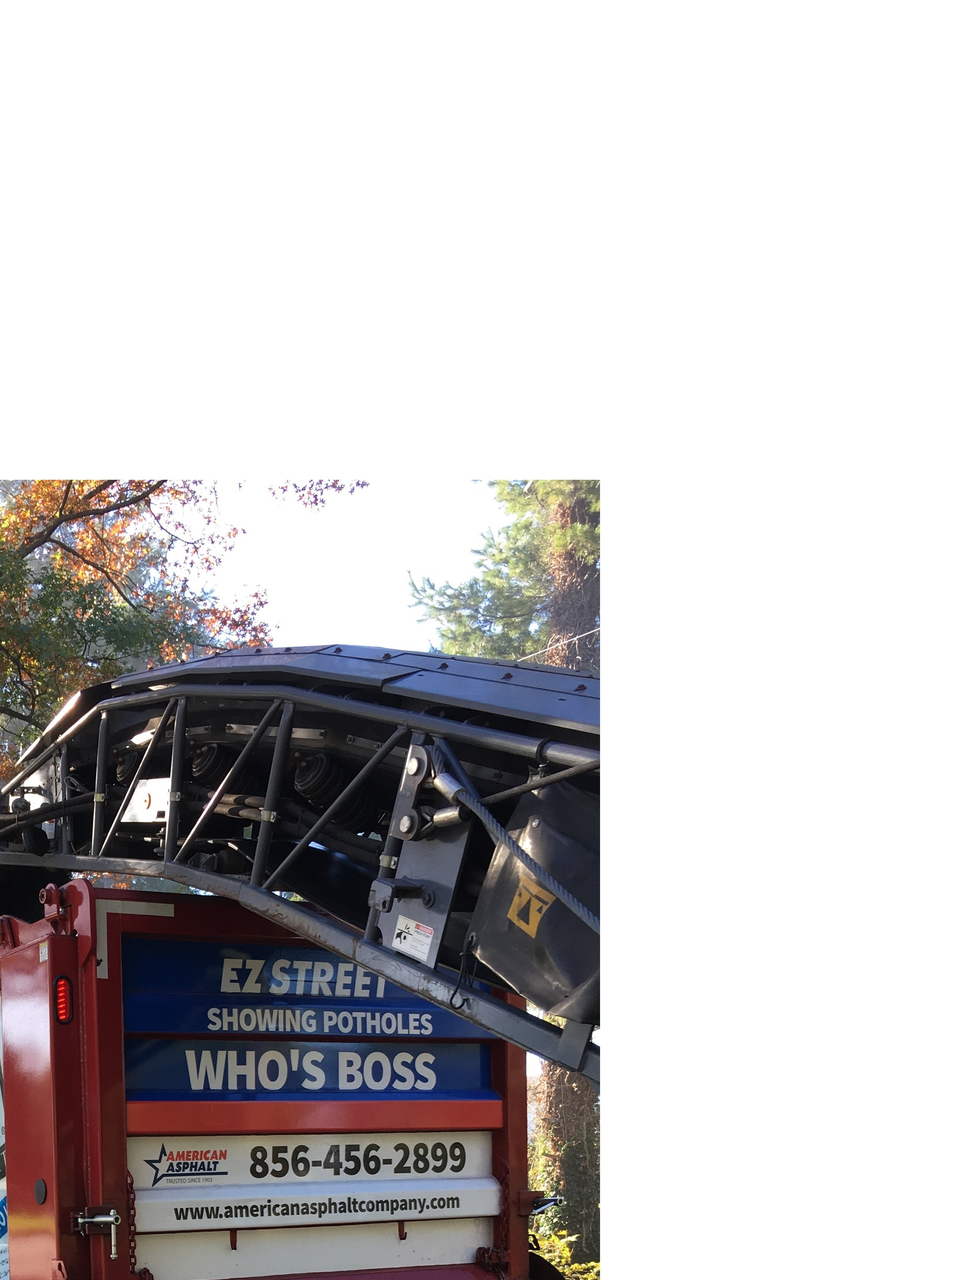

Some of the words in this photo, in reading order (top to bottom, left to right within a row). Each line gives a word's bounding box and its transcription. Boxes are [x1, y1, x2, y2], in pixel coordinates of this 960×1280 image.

[220, 958, 265, 994] EZ
[206, 1007, 317, 1033] SHOWING
[323, 1010, 434, 1036] POTHOLES
[185, 1049, 327, 1092] WHO'S
[338, 1051, 437, 1092] BOSS
[166, 1149, 228, 1162] AMERICAN
[166, 1161, 220, 1173] ASPHALT
[249, 1142, 467, 1179] 856-456-2899
[174, 1195, 460, 1221] www.americanasphaltcompany.com
